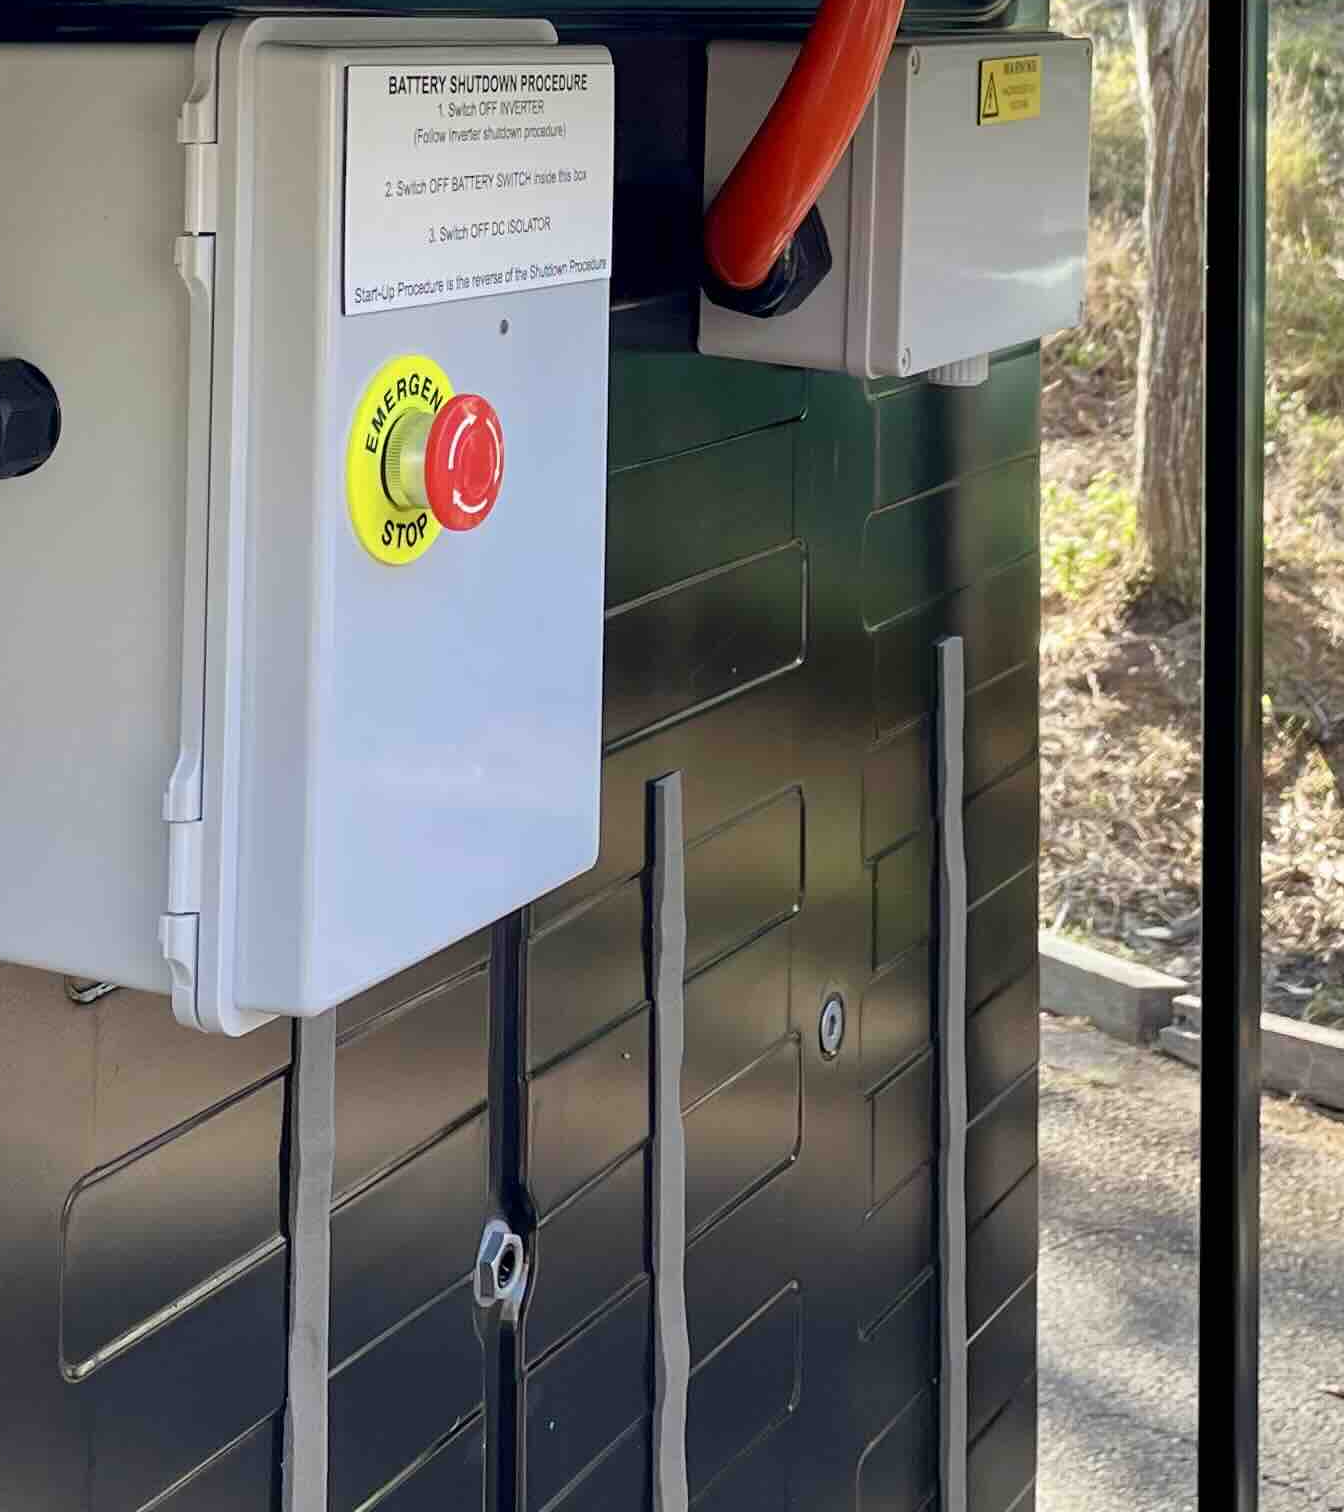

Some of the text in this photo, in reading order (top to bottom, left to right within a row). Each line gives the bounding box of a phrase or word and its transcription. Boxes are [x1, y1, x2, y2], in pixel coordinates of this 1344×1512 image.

[388, 74, 588, 95] BATTERY SHUTDOWN PROCEDURE
[448, 102, 477, 118] Switch
[479, 101, 497, 116] OFF
[500, 100, 544, 115] INVERTER
[483, 126, 522, 141] shutdown
[396, 180, 426, 197] Switch
[430, 177, 449, 194] OFF
[452, 173, 494, 192] BATTERY
[497, 172, 532, 188] SWITCH
[534, 171, 557, 184] inside
[558, 169, 572, 183] this
[574, 168, 587, 182] box
[440, 226, 468, 242] Switch
[471, 222, 489, 239] OFF
[492, 220, 505, 236] DC
[507, 216, 551, 234] ISOLATOR
[398, 279, 444, 297] Procedure
[456, 275, 470, 289] the
[472, 272, 503, 287] reverse
[505, 267, 513, 283] of
[515, 267, 528, 281] the
[530, 263, 568, 280] Shutdown
[569, 258, 607, 274] Procedure
[365, 373, 443, 454] EMERGEN
[381, 513, 428, 549] STOP
